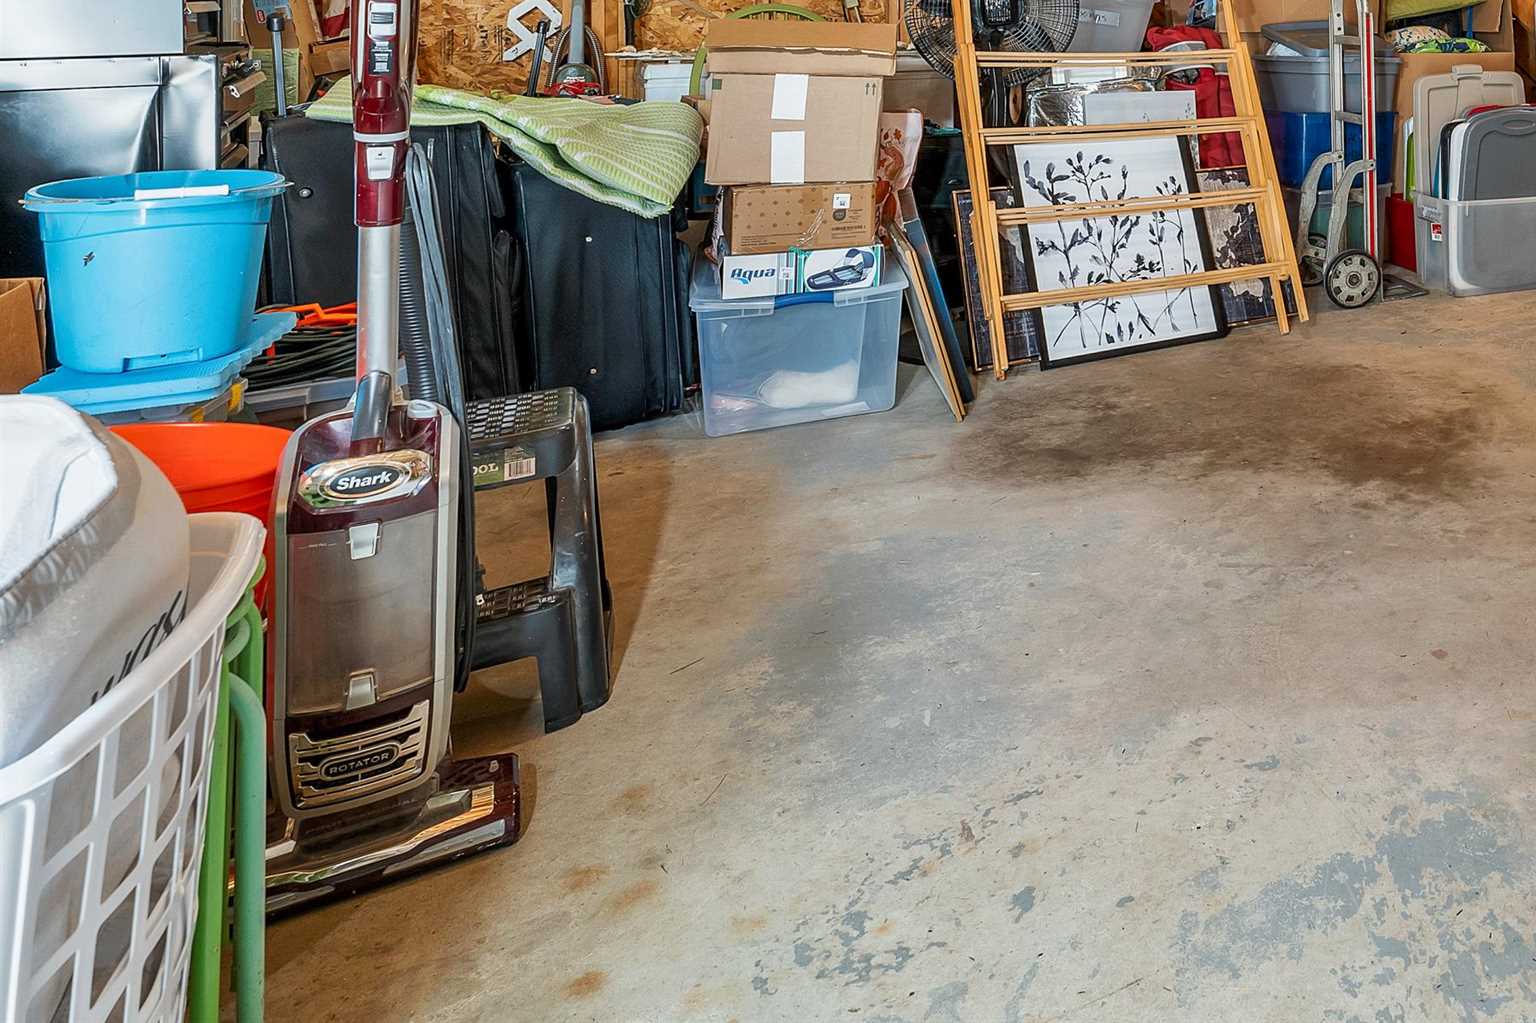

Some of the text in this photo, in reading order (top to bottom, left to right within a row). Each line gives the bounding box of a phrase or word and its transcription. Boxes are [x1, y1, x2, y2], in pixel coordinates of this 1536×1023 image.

[730, 268, 776, 283] Aqua
[336, 471, 392, 491] Shark
[328, 752, 390, 775] ROTATOR
